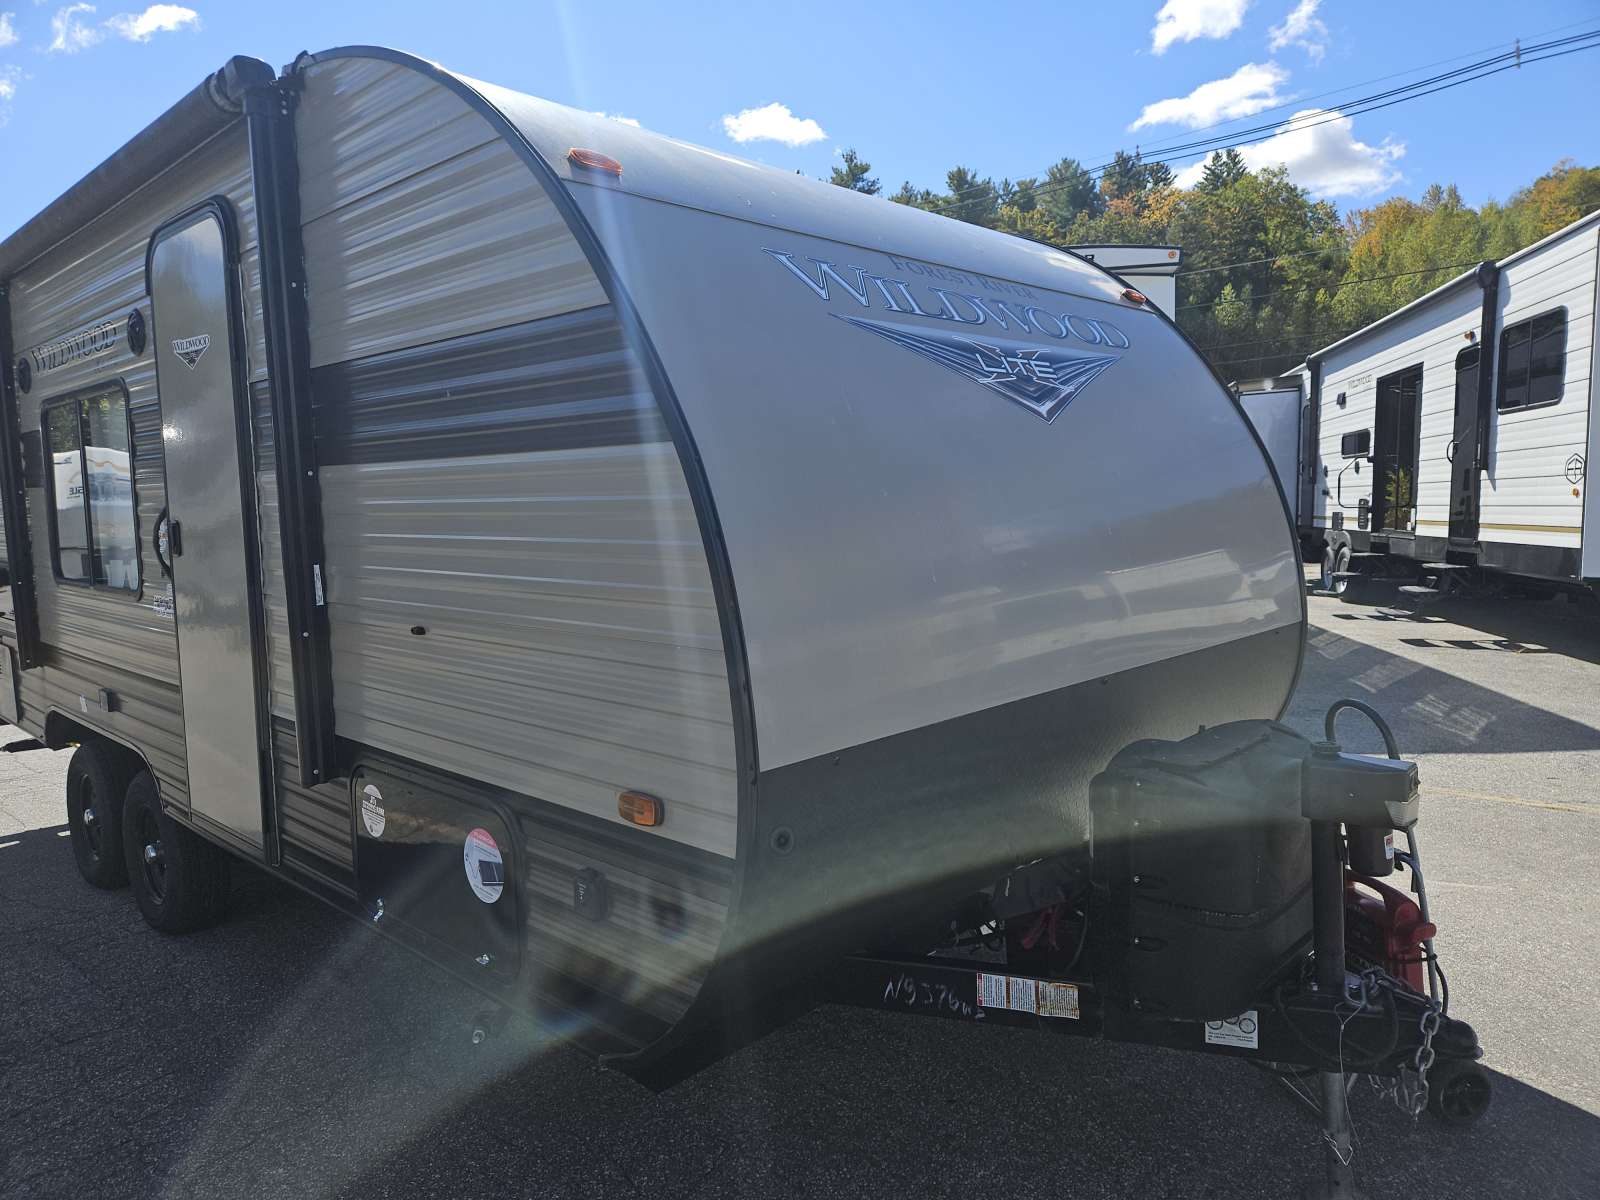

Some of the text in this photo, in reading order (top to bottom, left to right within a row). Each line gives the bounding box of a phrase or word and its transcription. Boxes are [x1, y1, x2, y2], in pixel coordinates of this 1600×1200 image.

[761, 246, 1130, 349] WILDWOOD
[888, 256, 1040, 301] FOREST RIVER
[31, 320, 117, 373] WILDWOOD
[172, 335, 210, 353] WILDWOOD
[975, 352, 1059, 380] LITE
